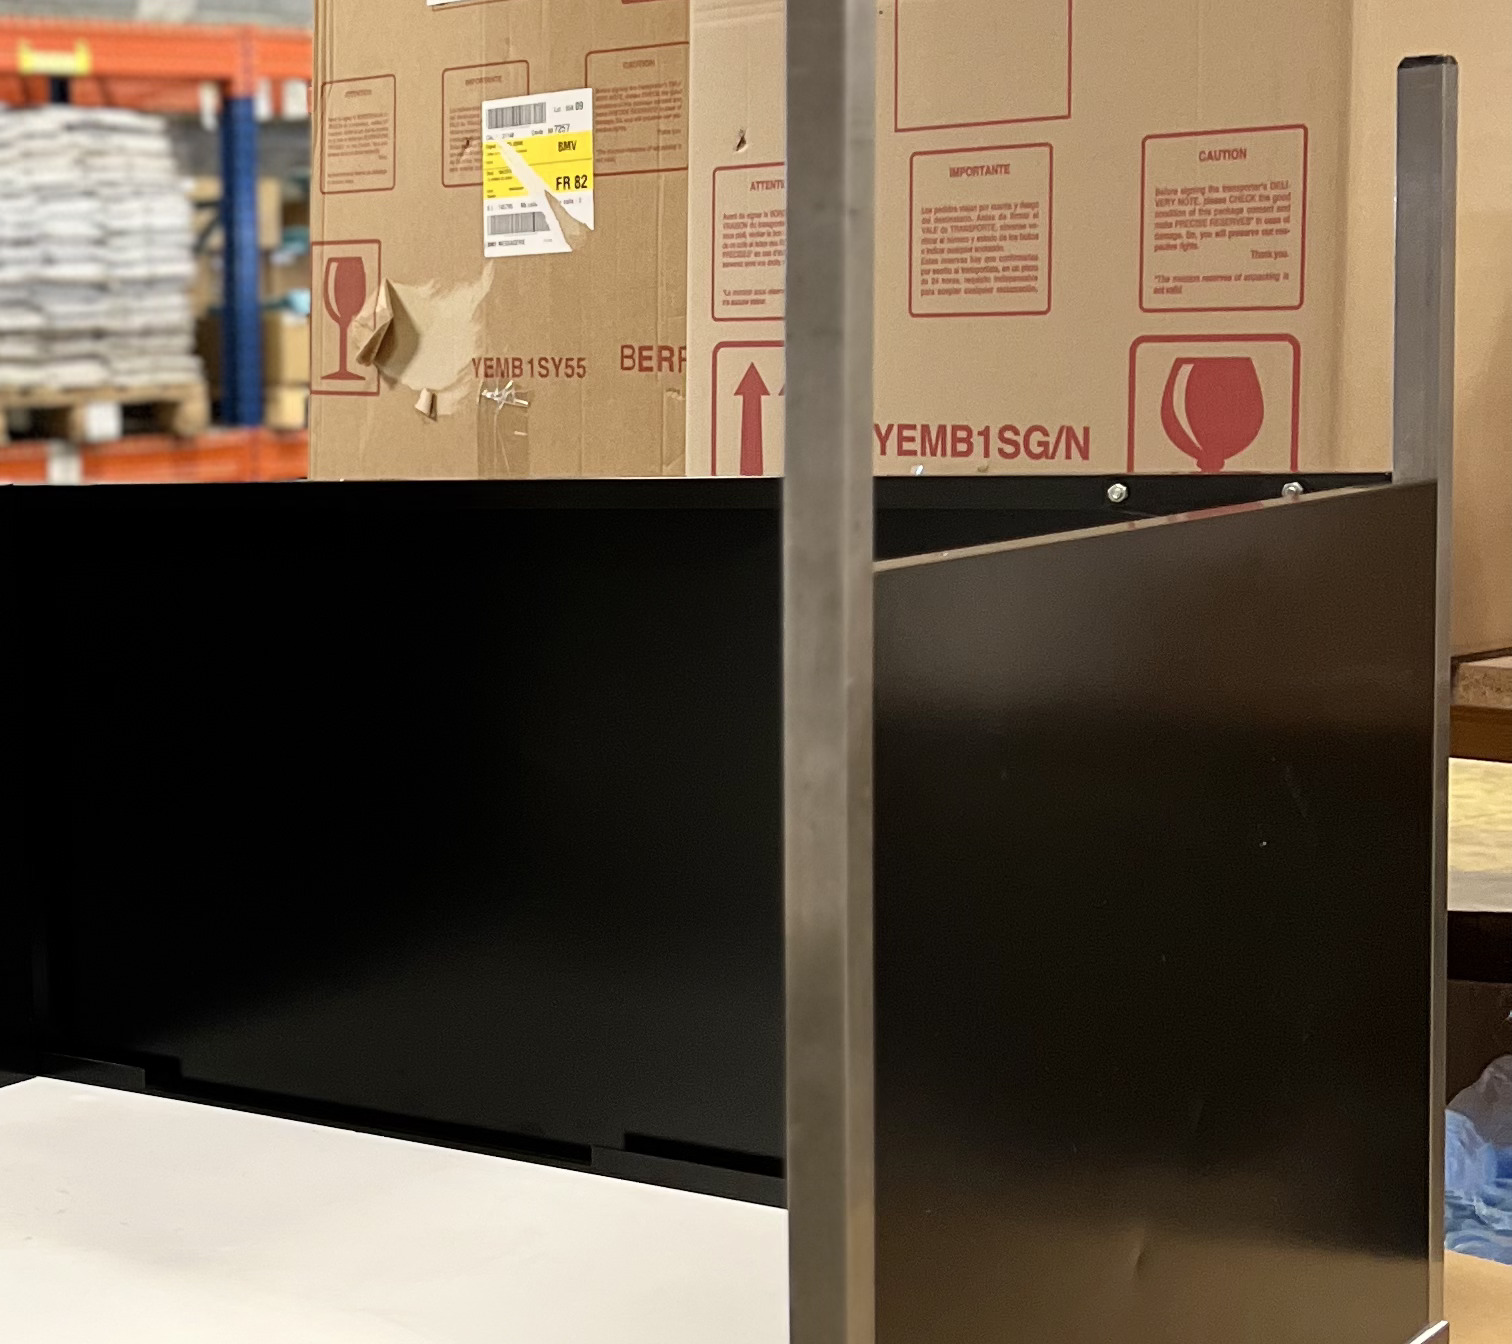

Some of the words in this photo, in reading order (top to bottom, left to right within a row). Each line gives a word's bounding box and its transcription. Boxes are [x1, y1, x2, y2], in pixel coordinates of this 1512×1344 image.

[558, 140, 577, 152] BMV
[1198, 148, 1248, 162] CAUTION
[949, 163, 1011, 178] IMPORTANTE
[555, 176, 570, 191] FR
[574, 174, 588, 189] 82
[749, 180, 785, 192] ATTENTI
[471, 357, 587, 379] YEMB1SY55
[874, 423, 1091, 461] YEMB1SG/N
